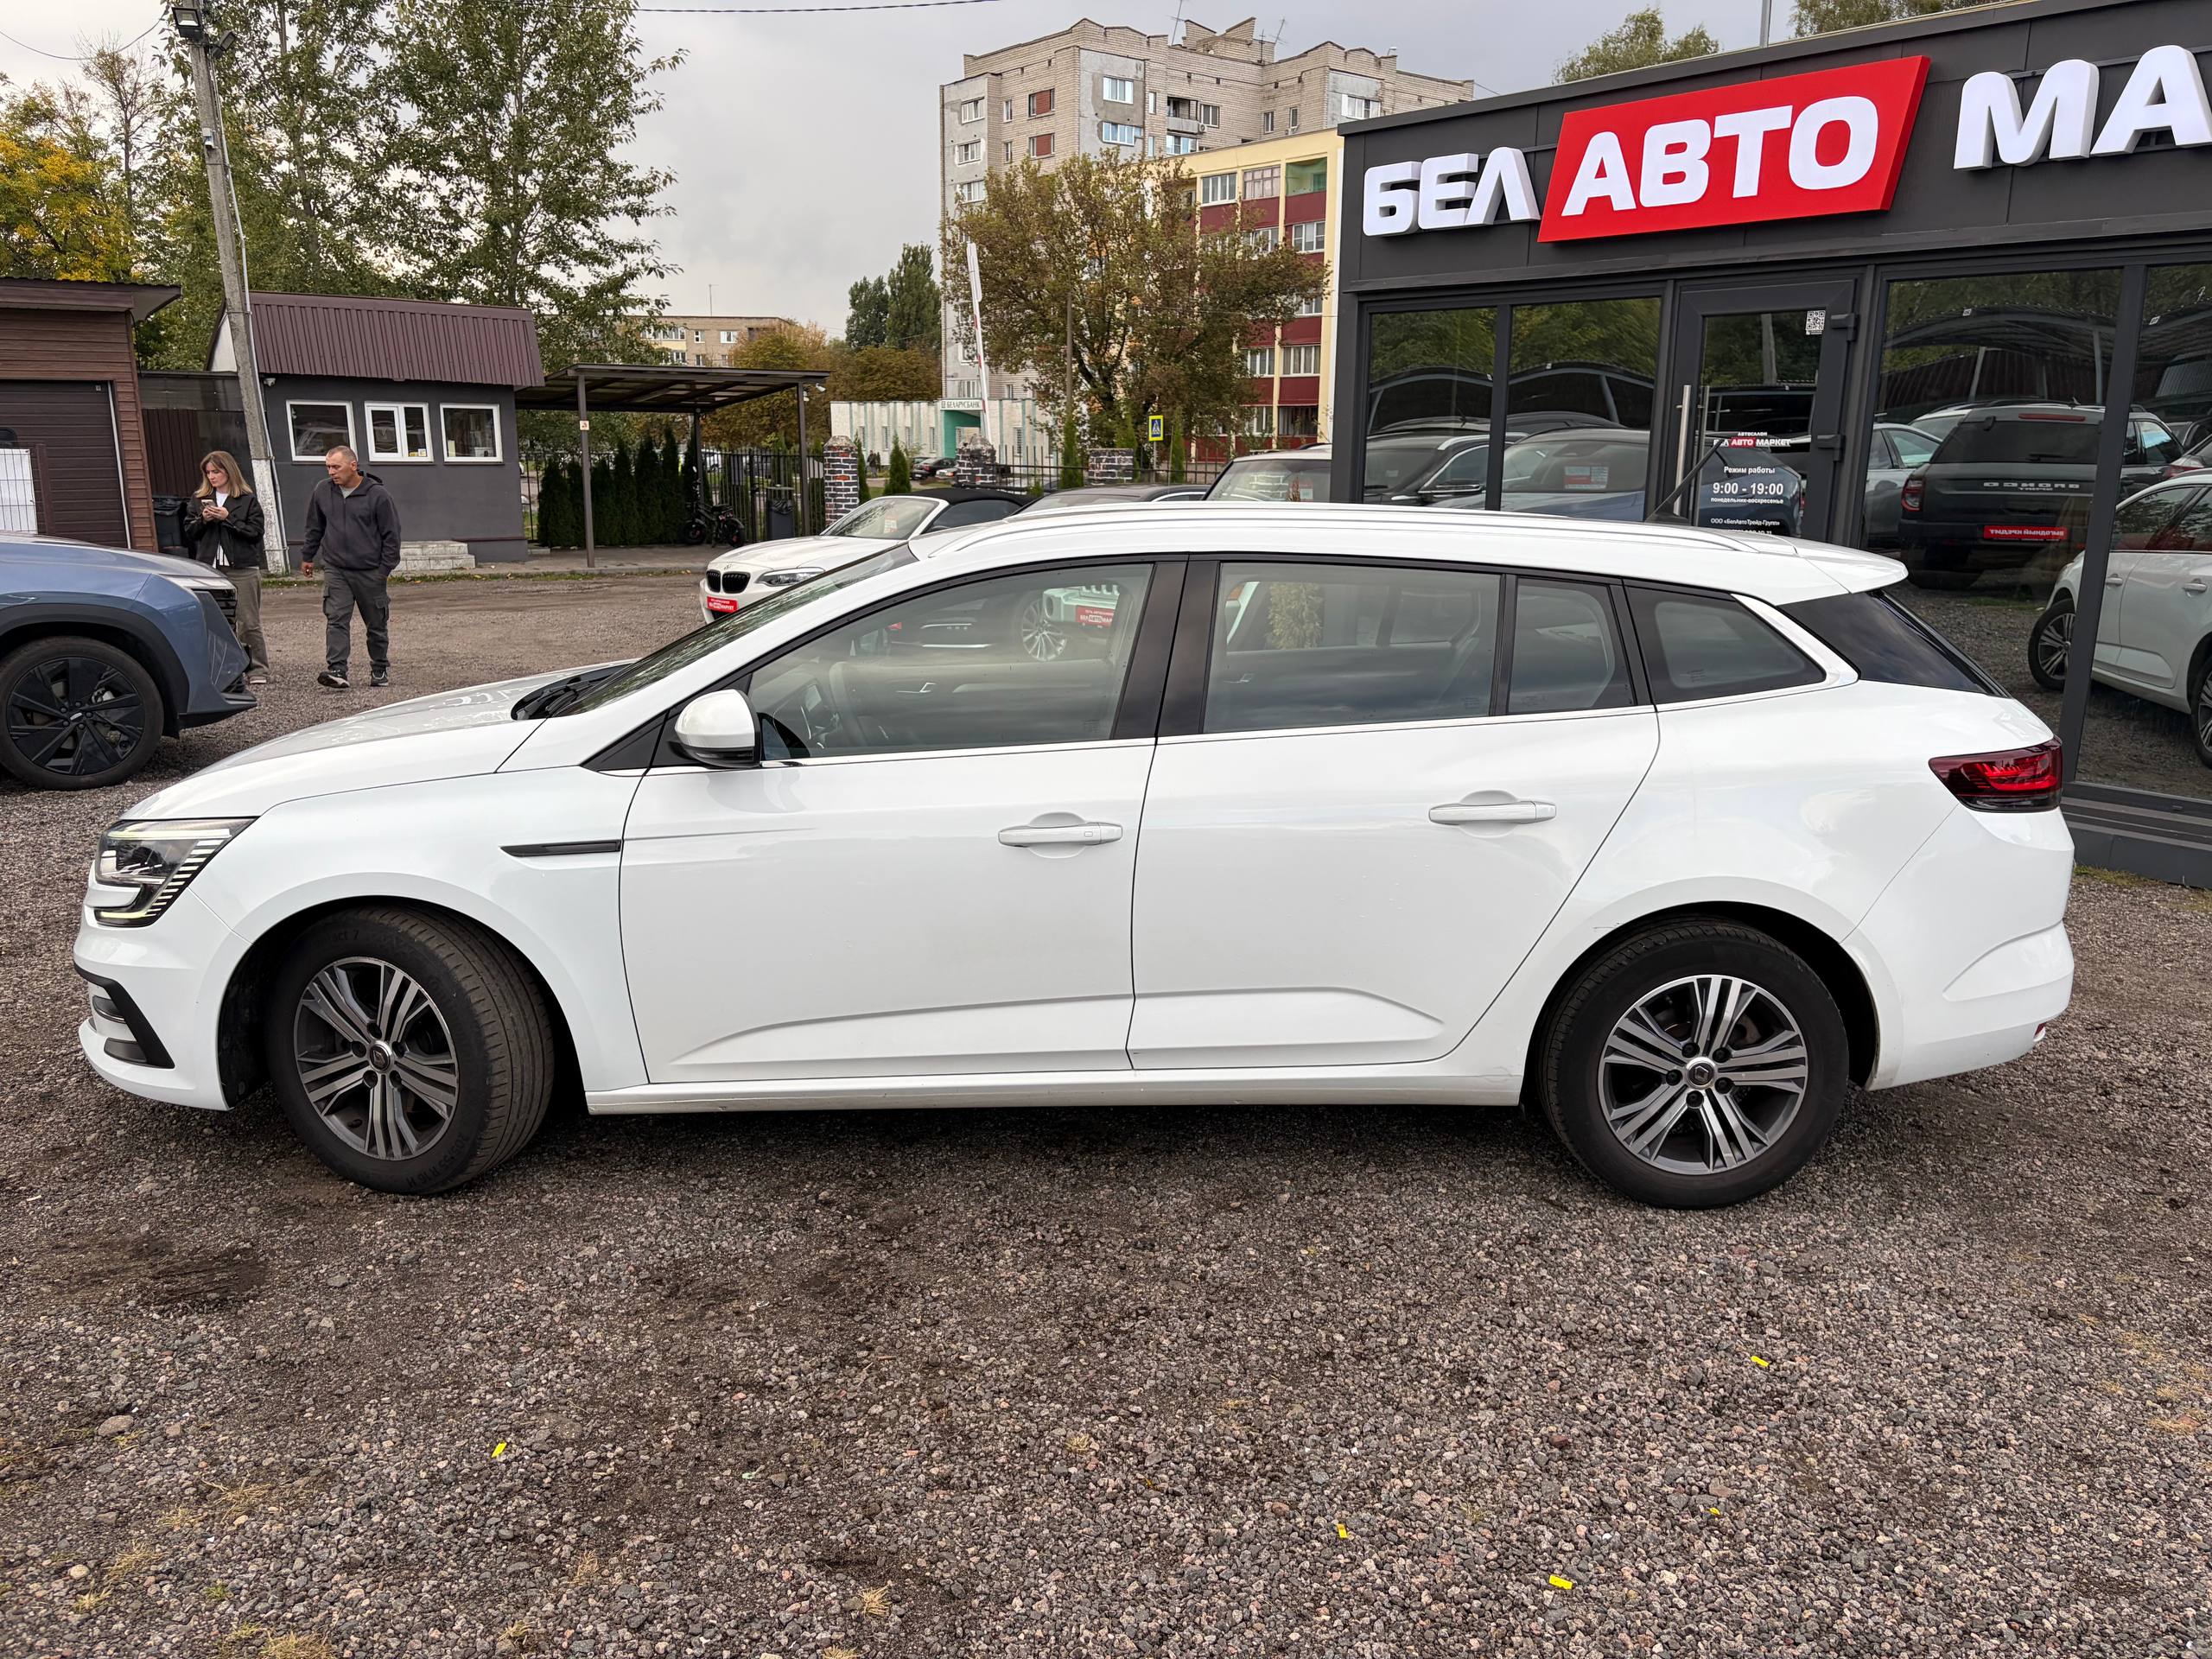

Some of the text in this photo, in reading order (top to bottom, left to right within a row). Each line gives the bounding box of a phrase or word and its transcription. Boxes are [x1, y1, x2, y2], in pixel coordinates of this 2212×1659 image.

[1363, 44, 2212, 237] БЕЛ АВТО МА
[1756, 439, 1791, 448] МАРКЕТ
[1713, 482, 1738, 494] 9:00
[1750, 482, 1784, 495] 19:00
